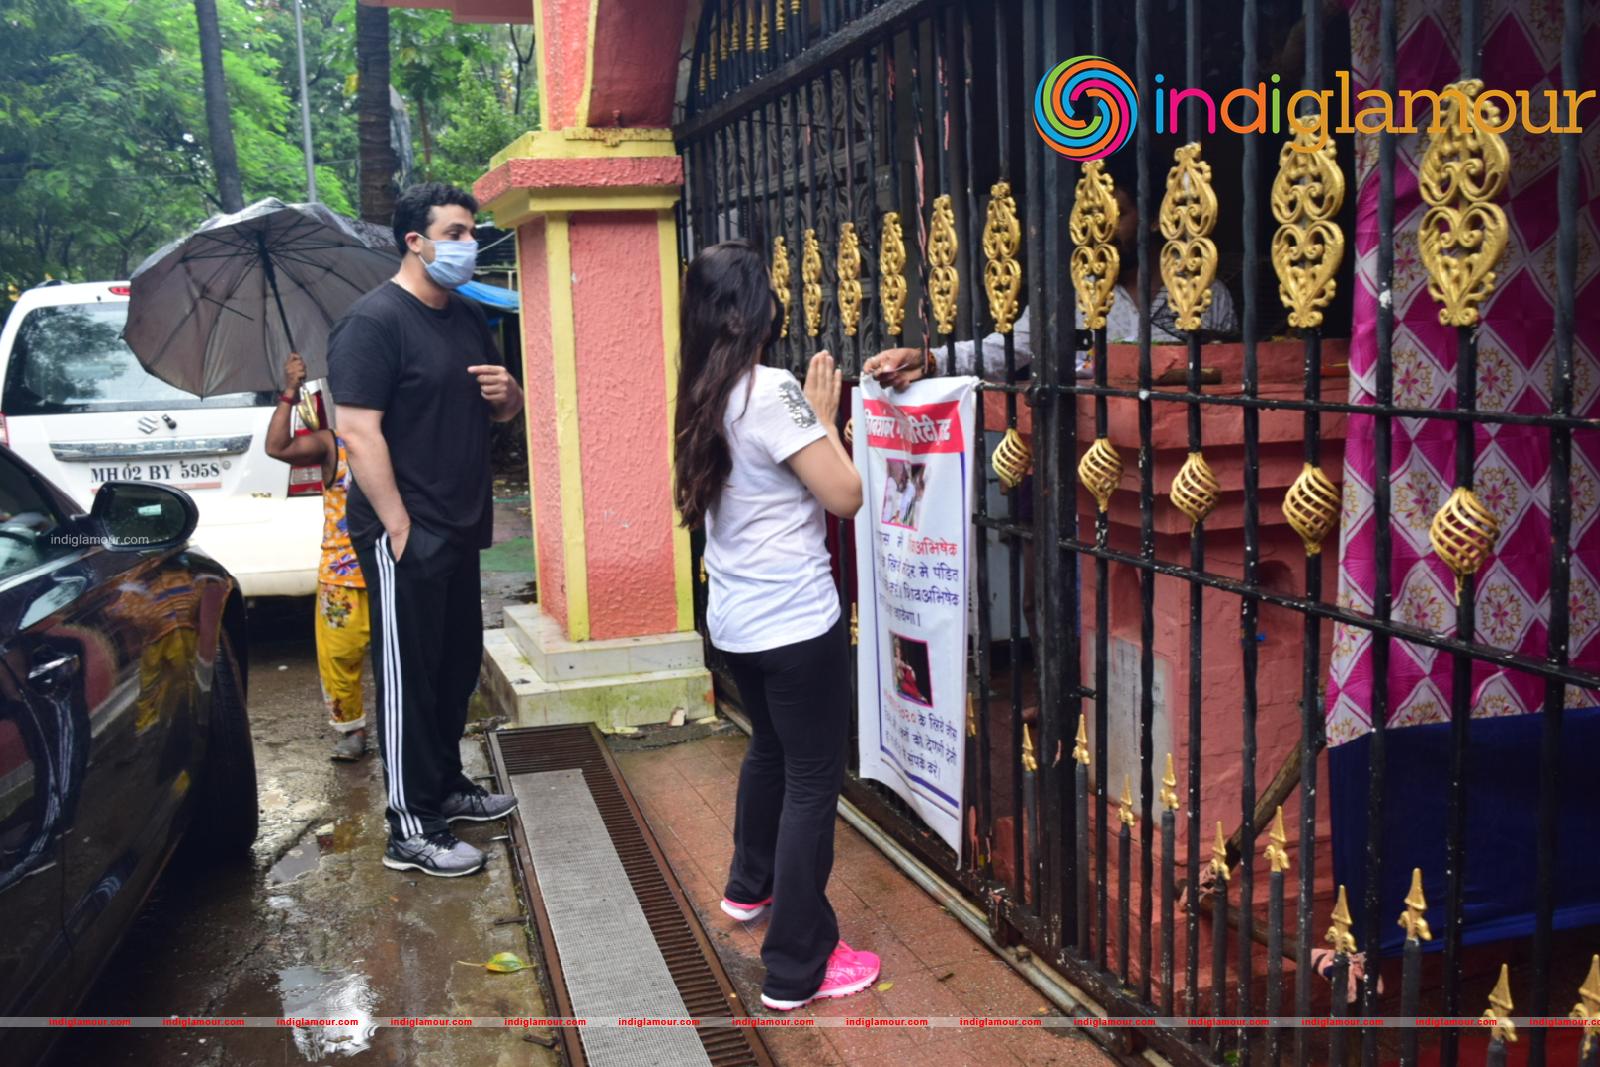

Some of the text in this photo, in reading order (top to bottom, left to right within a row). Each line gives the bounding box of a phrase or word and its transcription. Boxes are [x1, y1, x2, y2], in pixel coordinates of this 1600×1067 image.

[90, 462, 220, 483] MH 02 BY 5958
